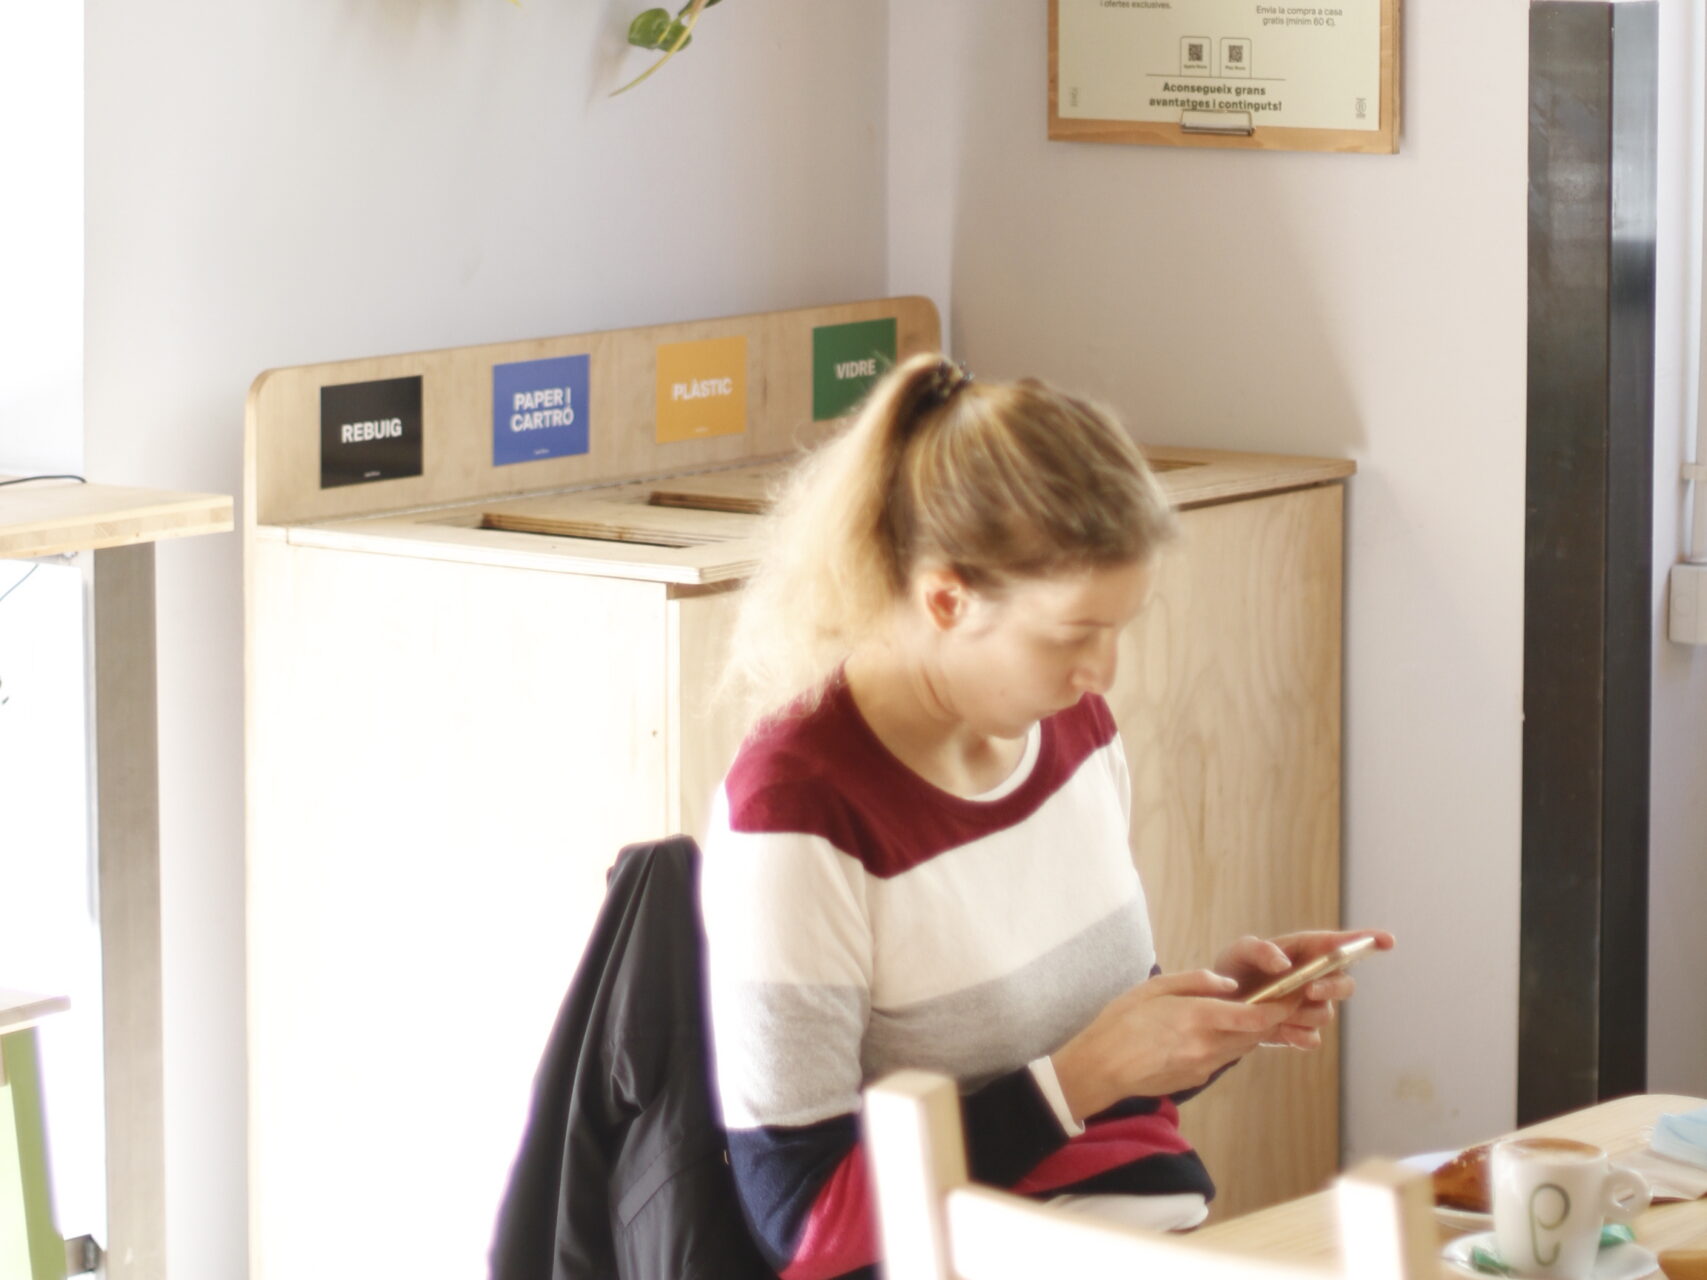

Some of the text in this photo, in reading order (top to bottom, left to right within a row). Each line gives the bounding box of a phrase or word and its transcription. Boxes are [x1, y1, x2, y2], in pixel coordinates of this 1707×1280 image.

[1163, 82, 1266, 97] Aconsegueix grans
[1149, 97, 1210, 111] avantatges
[1218, 99, 1282, 112] continguts!
[835, 358, 876, 380] VIDRE
[514, 387, 571, 411] PAPER I
[672, 377, 733, 401] PLÀSTIC
[341, 417, 403, 443] REBUIG
[510, 406, 575, 433] CARTRÓ
